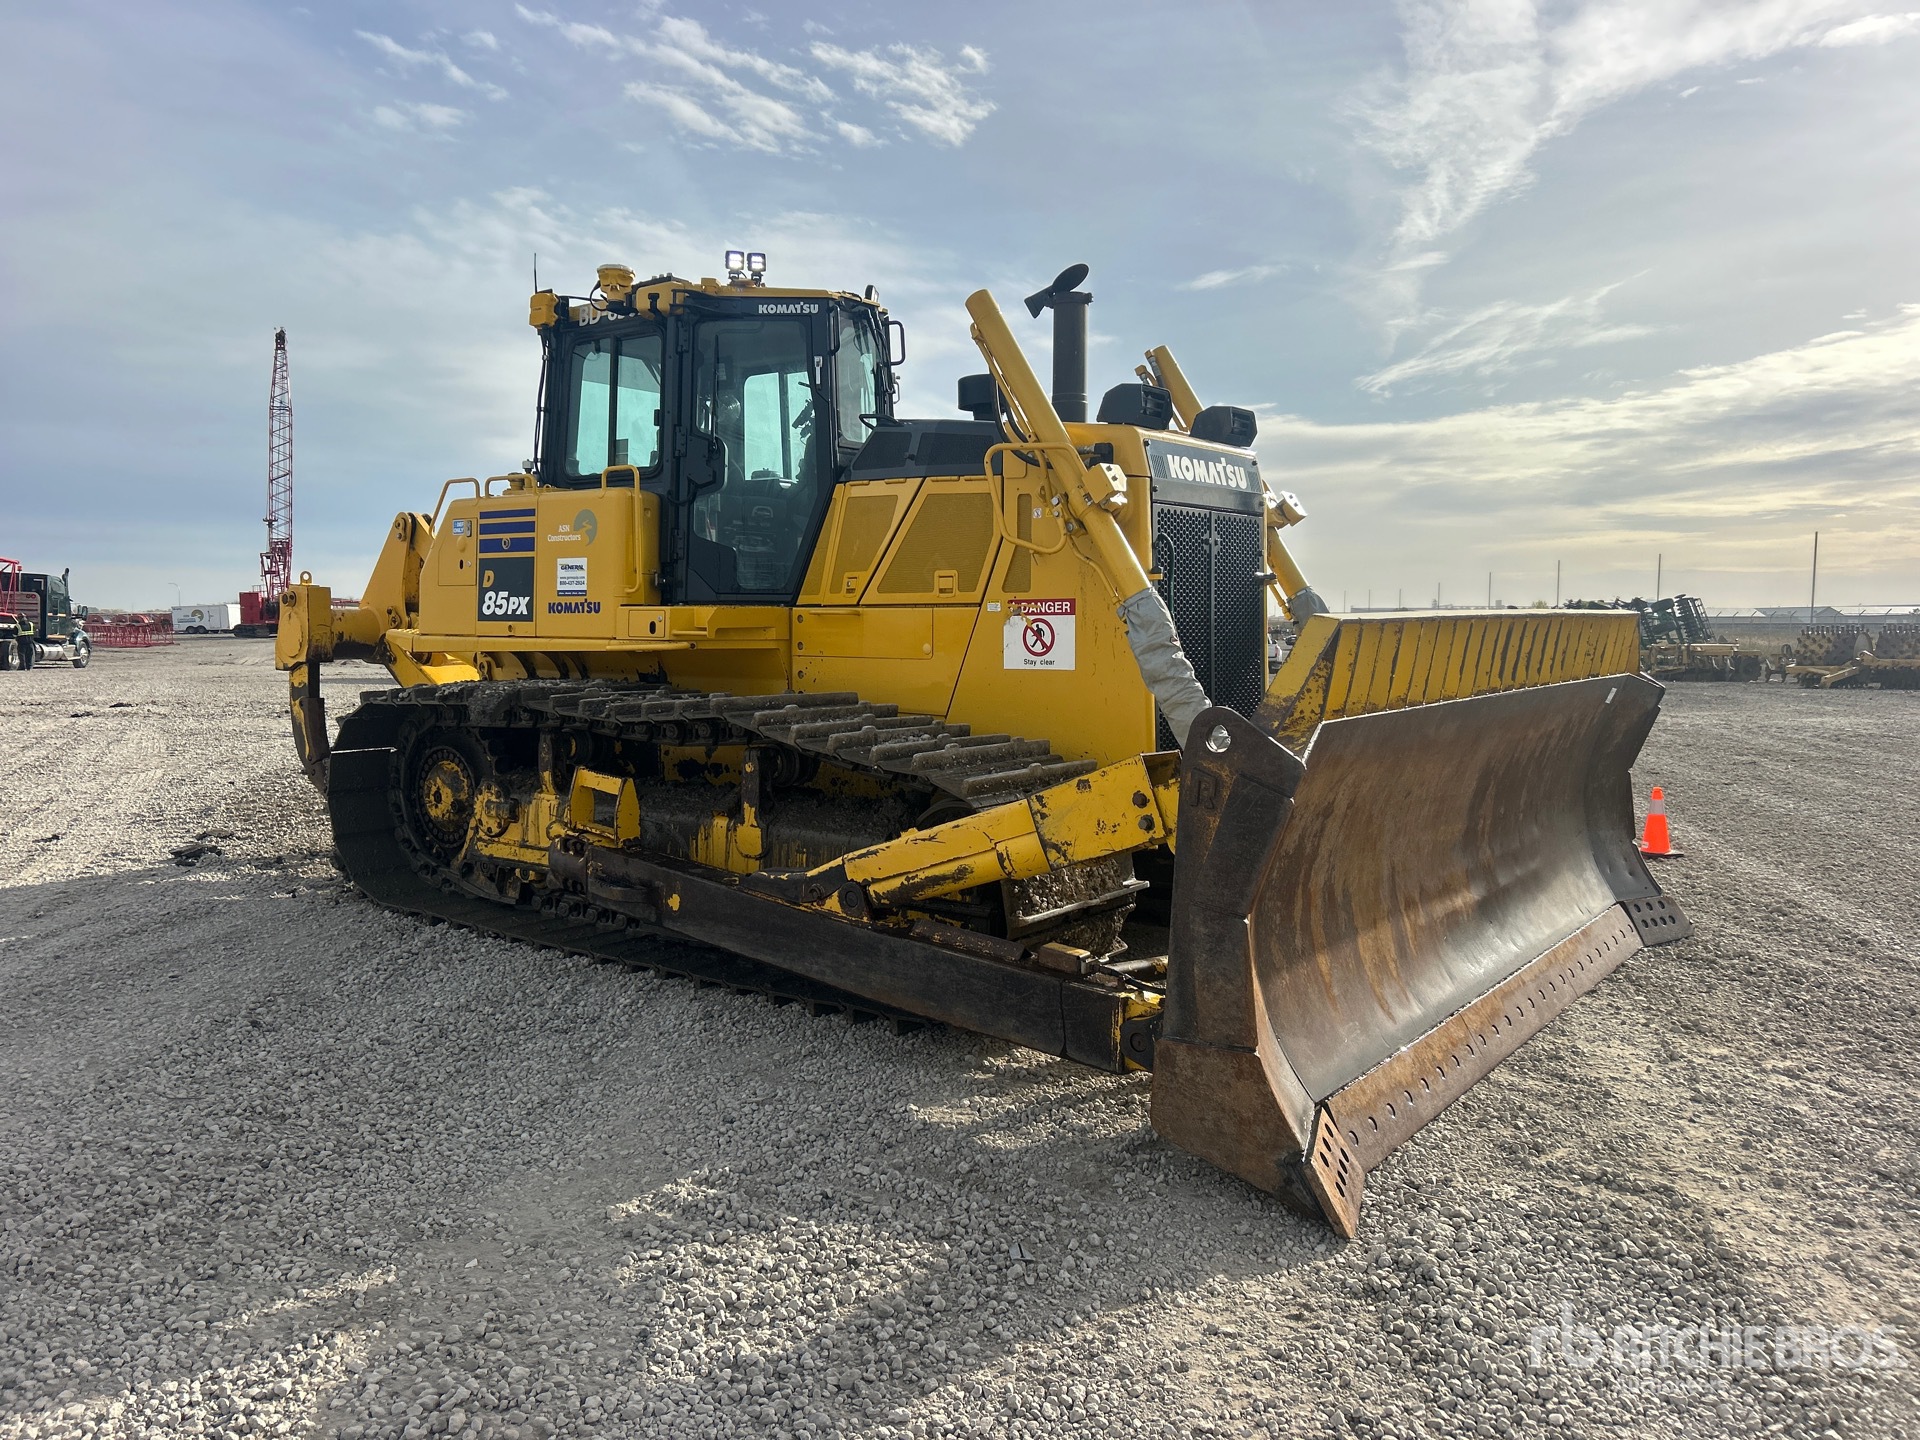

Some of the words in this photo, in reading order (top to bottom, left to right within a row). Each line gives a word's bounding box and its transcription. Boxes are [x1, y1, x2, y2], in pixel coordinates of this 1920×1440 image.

[758, 301, 819, 314] KOMATSU
[1166, 454, 1247, 490] KOMATSU
[547, 534, 582, 542] Constructors
[482, 570, 495, 588] D
[481, 591, 531, 616] 85PX
[547, 598, 601, 614] KOMATSU
[1020, 601, 1071, 613] DANGER
[1023, 658, 1037, 667] Stay
[1039, 658, 1056, 666] clear
